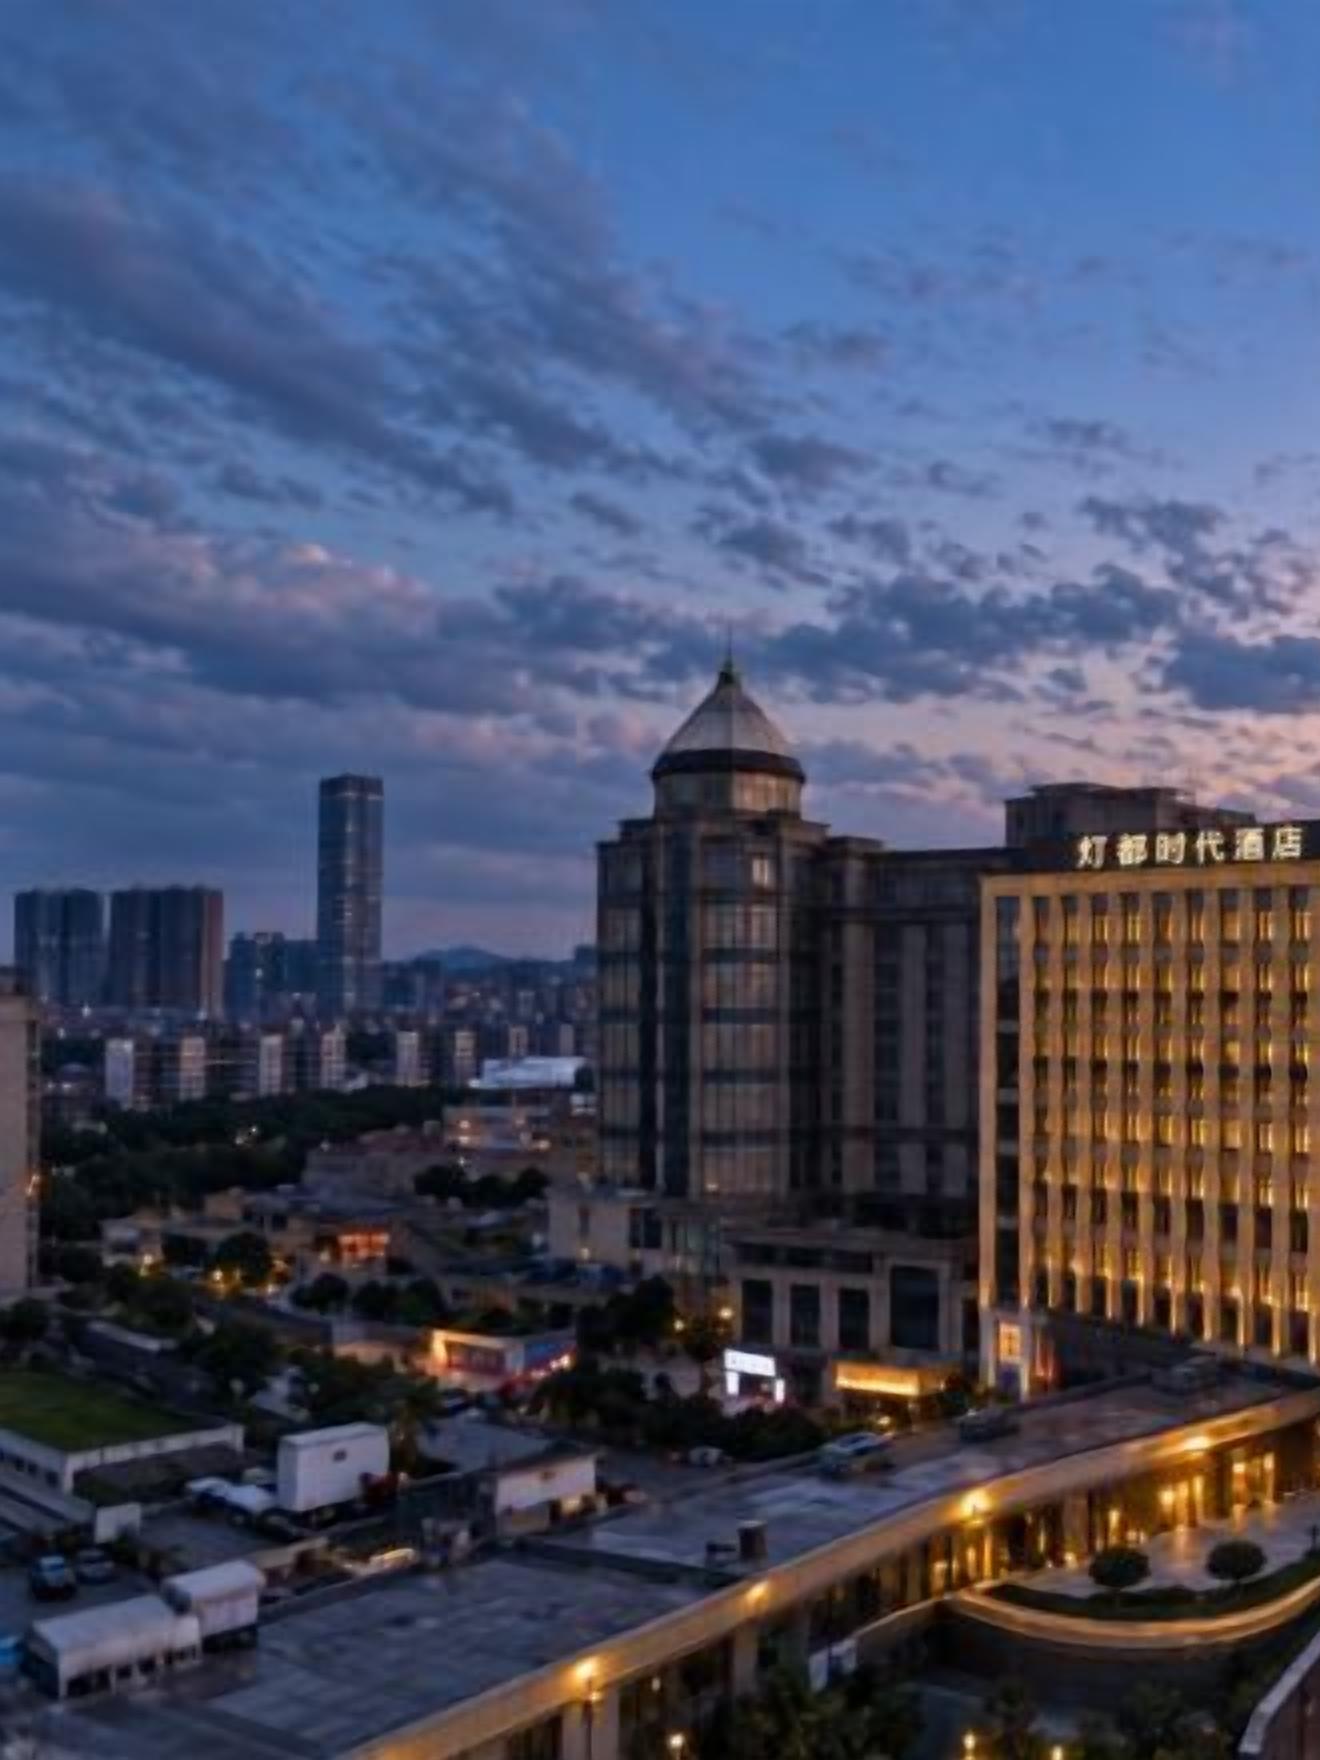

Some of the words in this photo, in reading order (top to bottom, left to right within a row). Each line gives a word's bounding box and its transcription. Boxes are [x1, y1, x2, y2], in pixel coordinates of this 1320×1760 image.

[1076, 826, 1303, 869] 灯都时代酒店
